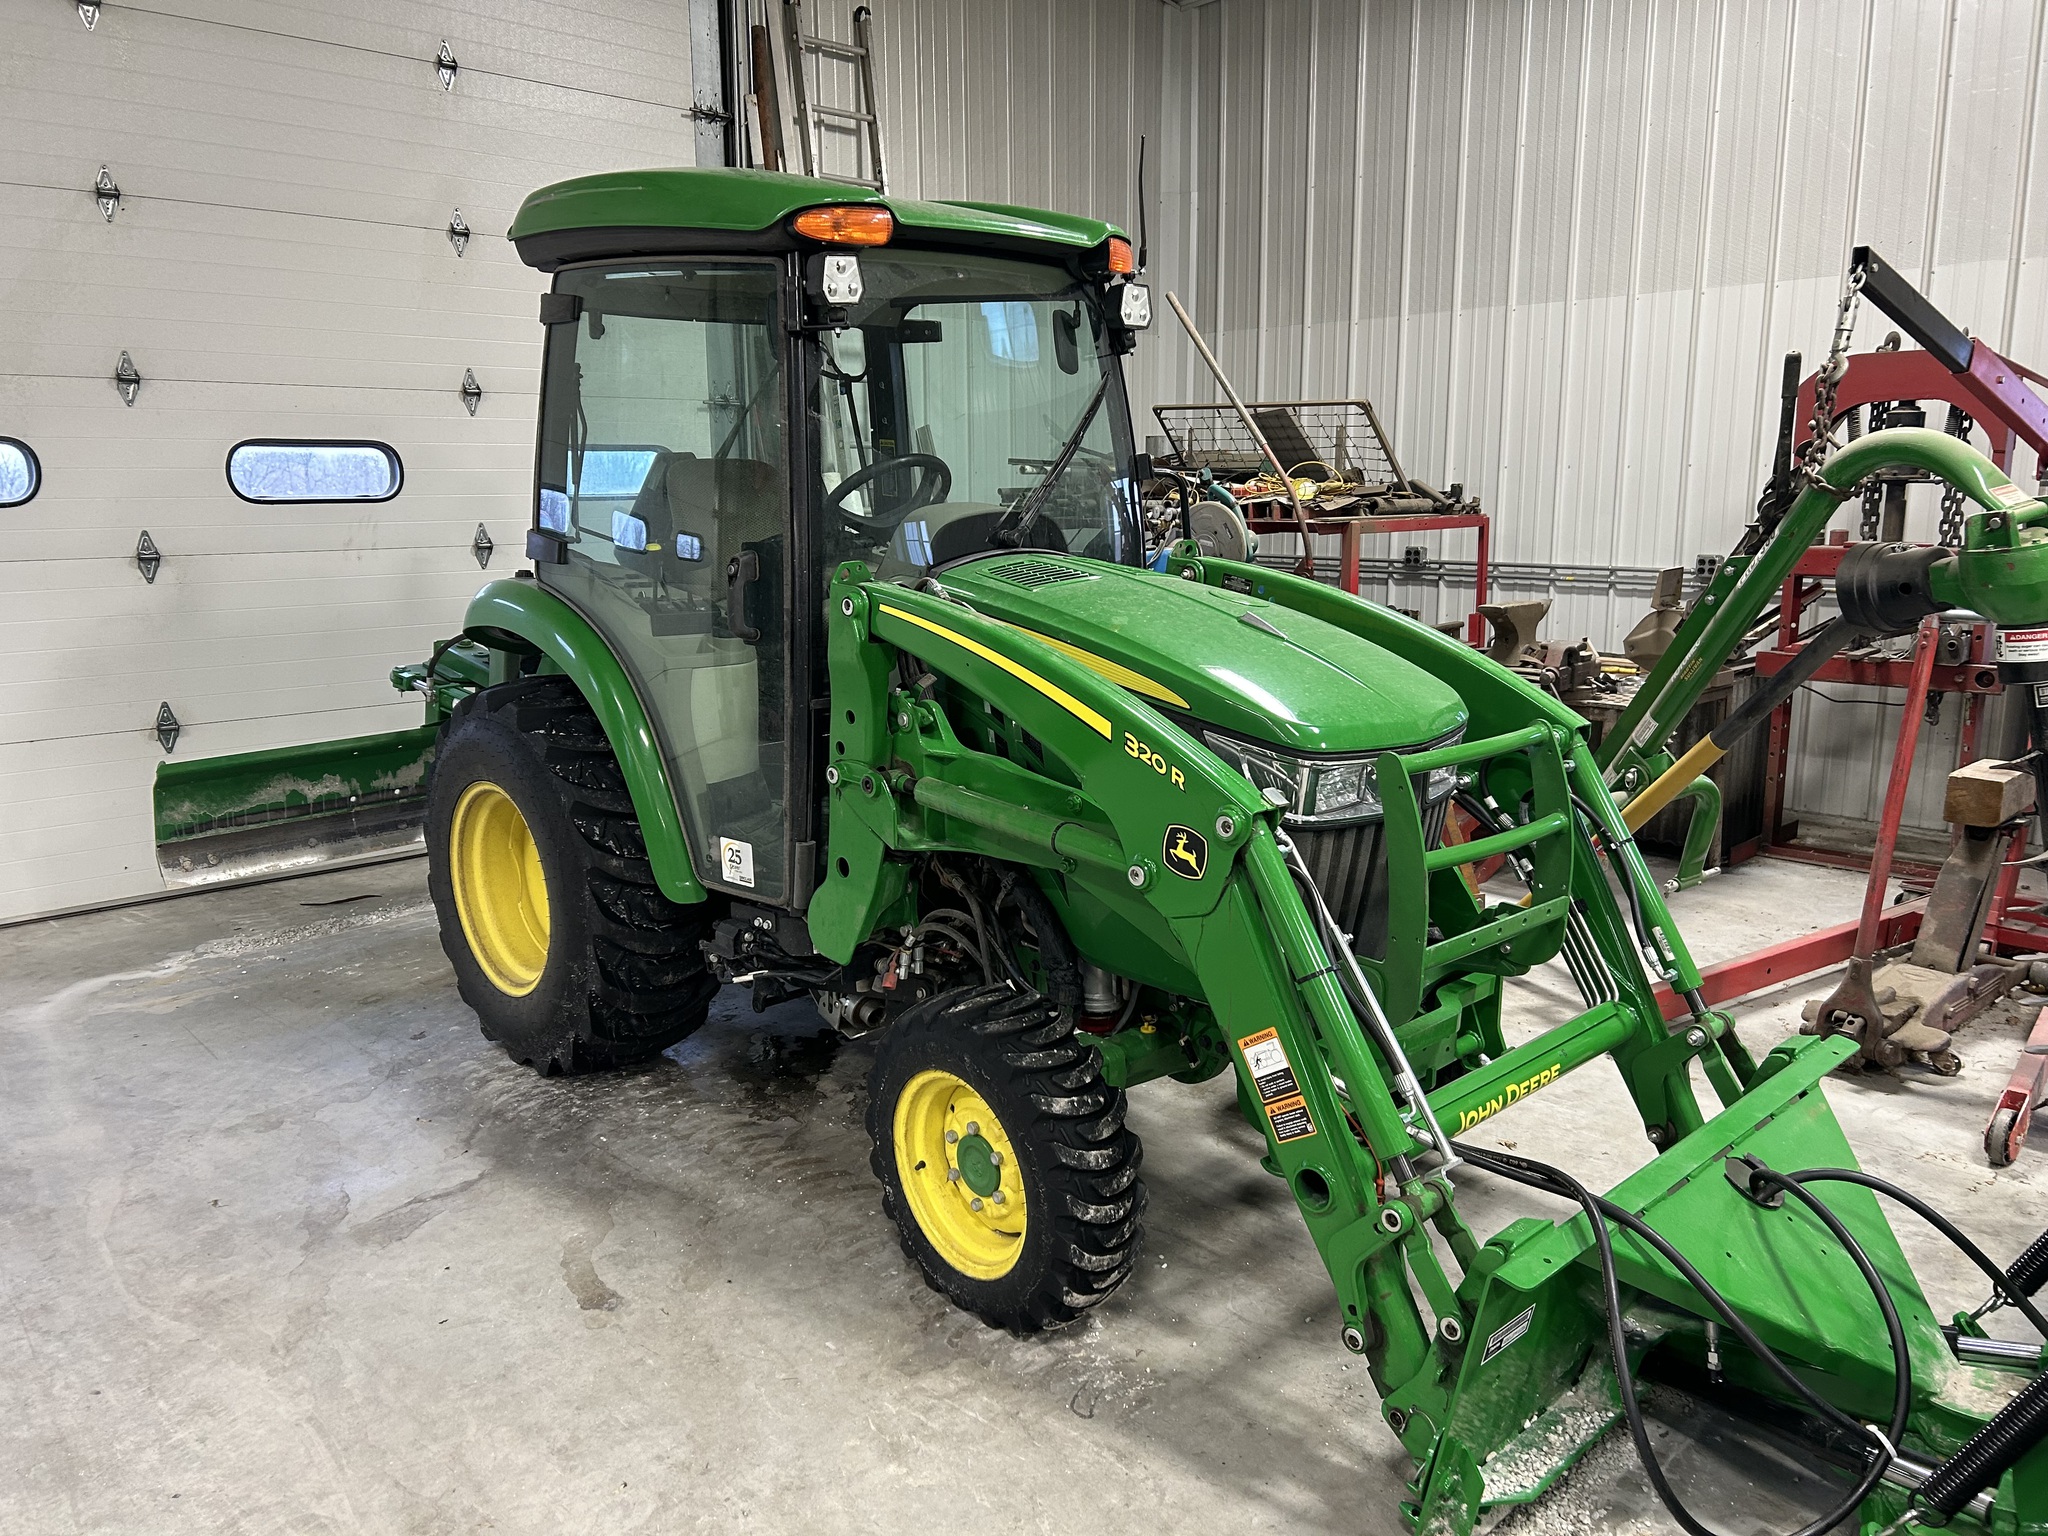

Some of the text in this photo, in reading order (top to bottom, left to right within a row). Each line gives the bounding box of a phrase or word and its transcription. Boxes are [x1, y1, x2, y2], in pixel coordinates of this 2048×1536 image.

[1124, 731, 1186, 791] 320 R
[728, 847, 742, 865] 25
[1249, 1031, 1273, 1044] WARNING
[1276, 1100, 1302, 1112] WARNING
[1453, 1063, 1561, 1137] JOHN DEERE
